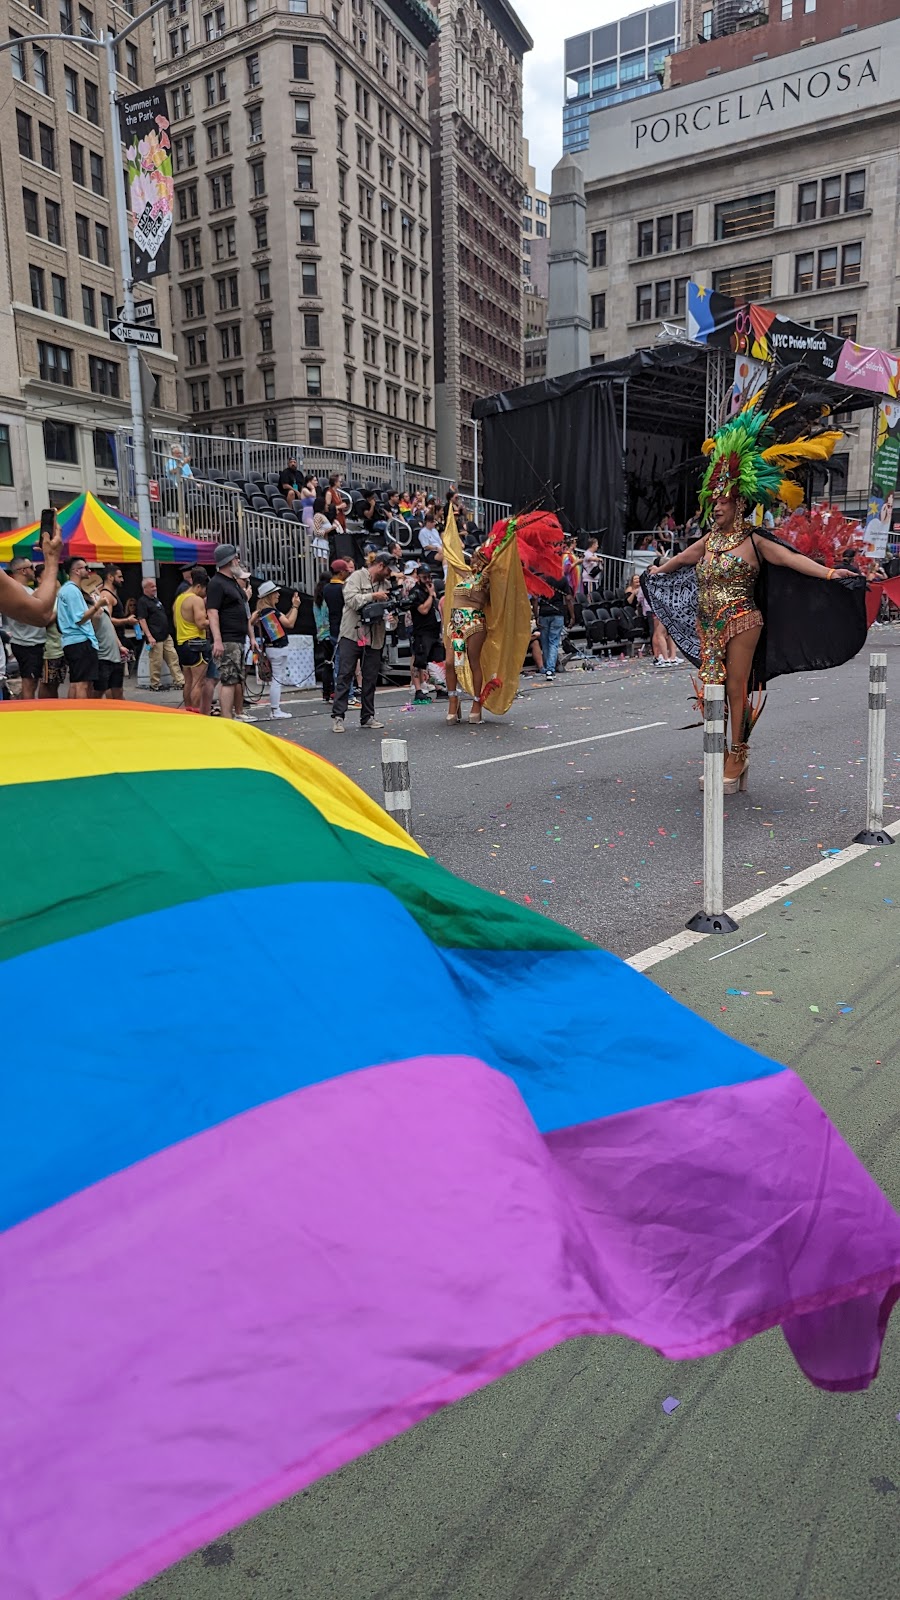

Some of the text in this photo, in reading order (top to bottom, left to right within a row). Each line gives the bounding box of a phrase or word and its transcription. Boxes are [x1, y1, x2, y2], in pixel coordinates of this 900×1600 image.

[124, 95, 160, 113] Summer in
[635, 58, 877, 149] PORCELANOSA
[126, 109, 154, 126] the Park
[137, 305, 150, 317] WAY
[116, 327, 155, 342] ONE WAY
[772, 333, 827, 350] NYC Pride March
[822, 355, 834, 369] 2023
[865, 361, 884, 375] Solidarity
